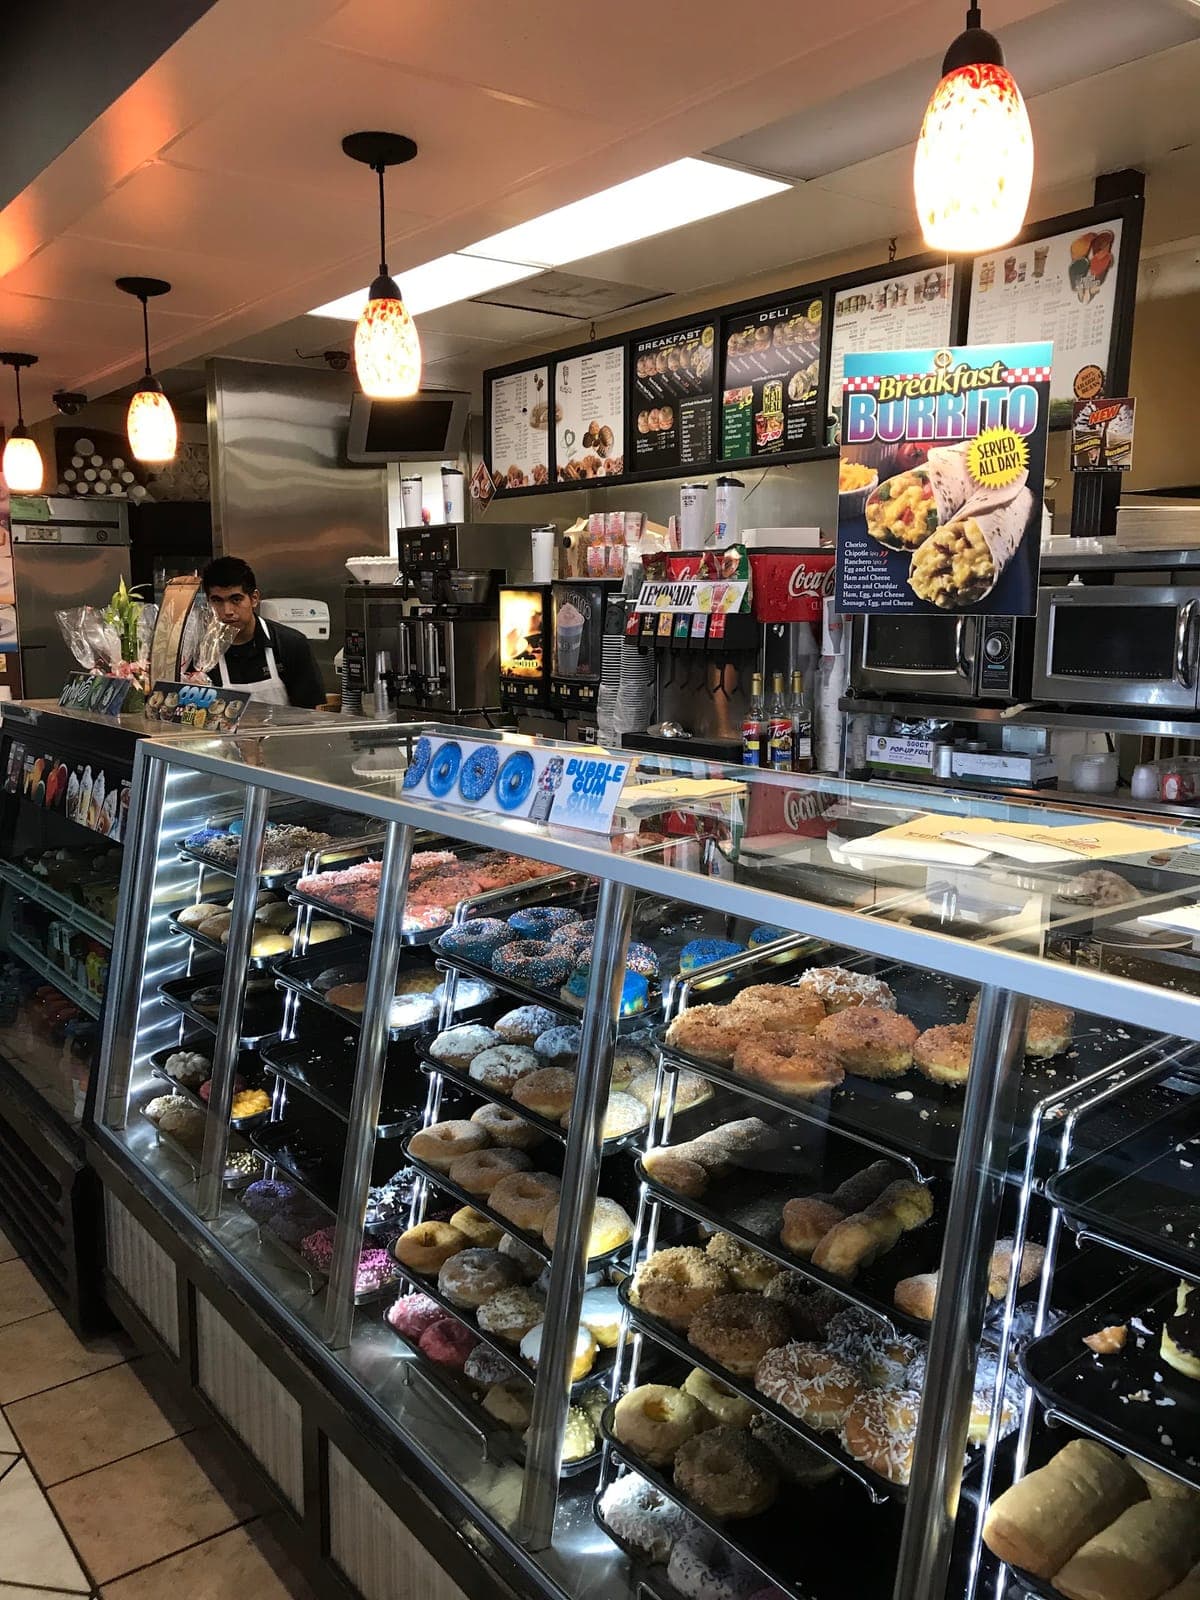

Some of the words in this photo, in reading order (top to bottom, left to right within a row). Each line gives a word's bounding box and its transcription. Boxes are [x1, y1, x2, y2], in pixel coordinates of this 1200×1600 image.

[760, 308, 788, 322] DELI
[638, 330, 701, 352] BREAKFAST
[879, 361, 1005, 401] Breakfast
[848, 384, 1040, 442] BURRITO
[1088, 403, 1122, 426] NEW
[977, 437, 1016, 460] SERVED
[979, 458, 998, 476] ALL
[999, 454, 1022, 472] DAY!
[566, 758, 625, 782] BUBBLE
[572, 776, 606, 796] GUM
